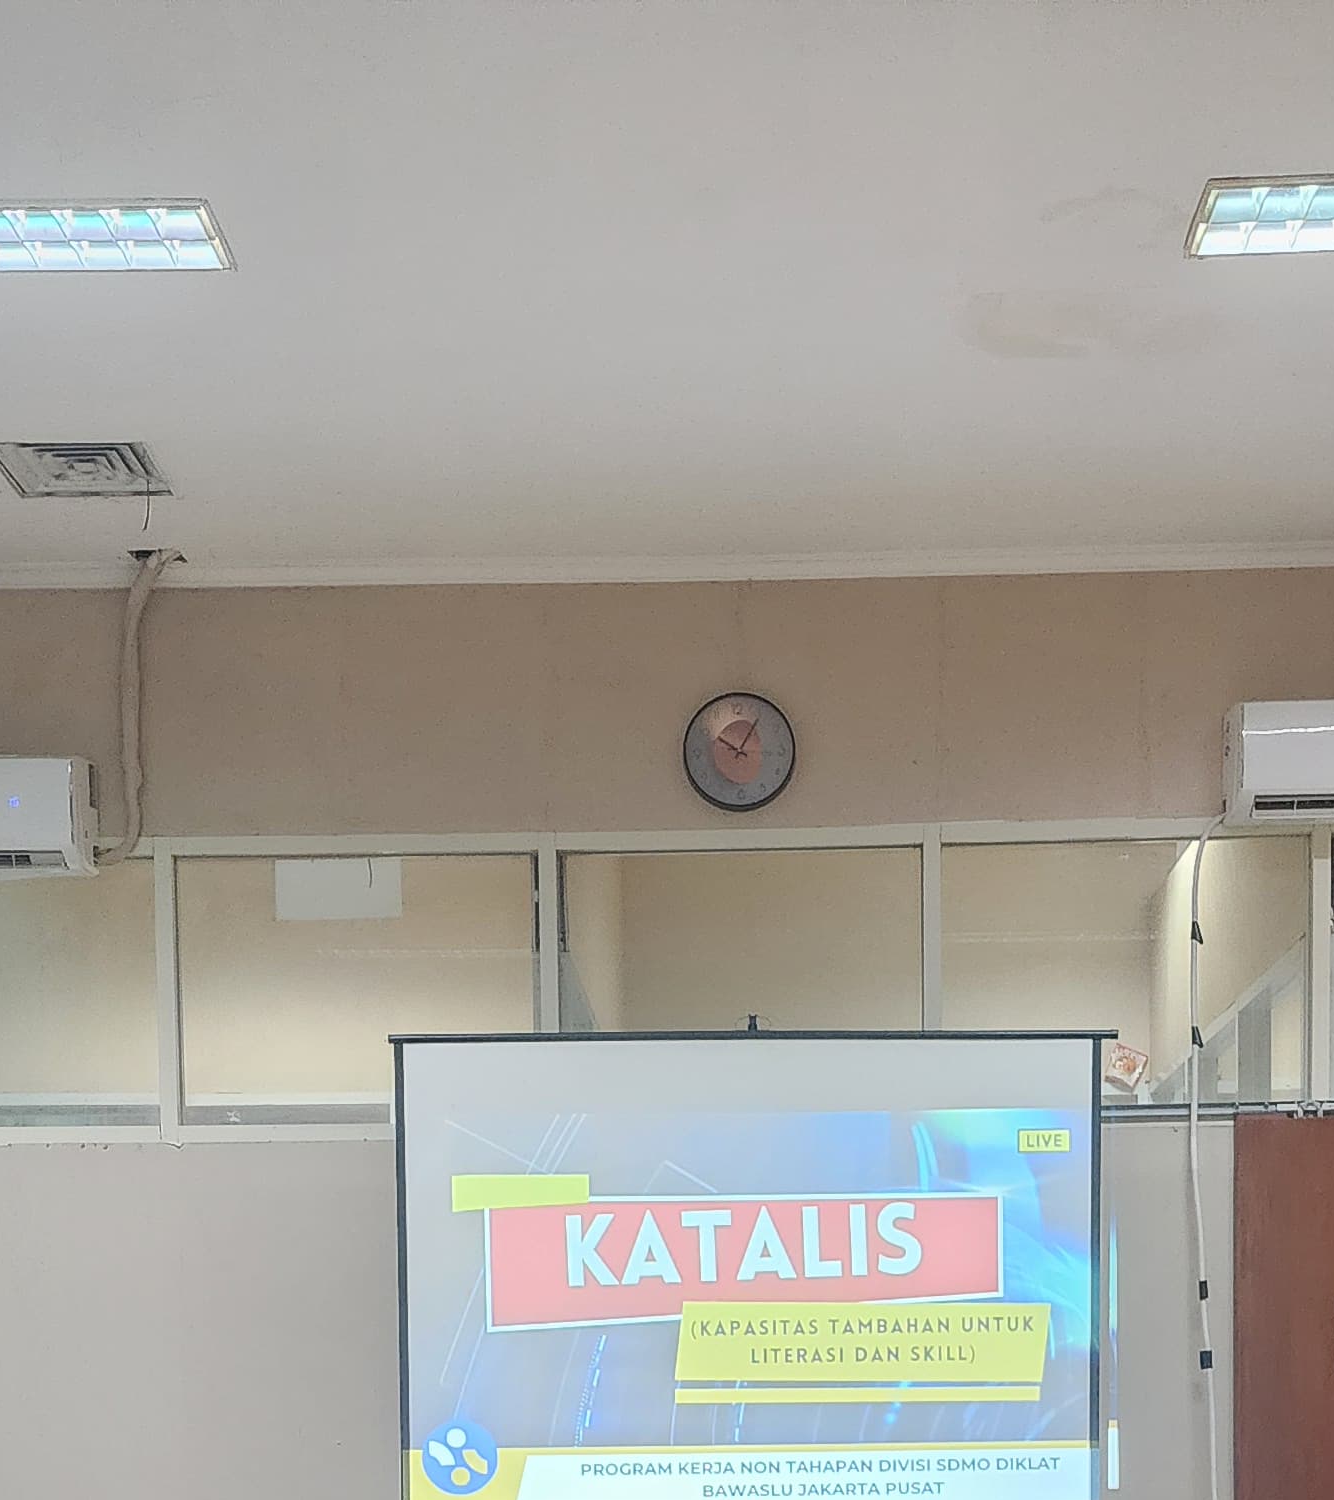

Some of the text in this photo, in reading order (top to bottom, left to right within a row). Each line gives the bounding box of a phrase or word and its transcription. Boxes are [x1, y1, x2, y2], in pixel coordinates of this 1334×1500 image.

[1026, 1133, 1063, 1148] LIVE
[565, 1200, 923, 1288] KATALIS
[691, 1315, 1035, 1340] (KAPASITAS TAMBAHAN UNTUK
[750, 1345, 976, 1364] LITERASI DAN SKILL)
[580, 1456, 1061, 1476] PROGRAM KERJA NON TAHAPAN DIVISI SDMO DIKLAT
[702, 1481, 945, 1498] BAWASLU JAKARTA PUSAT
